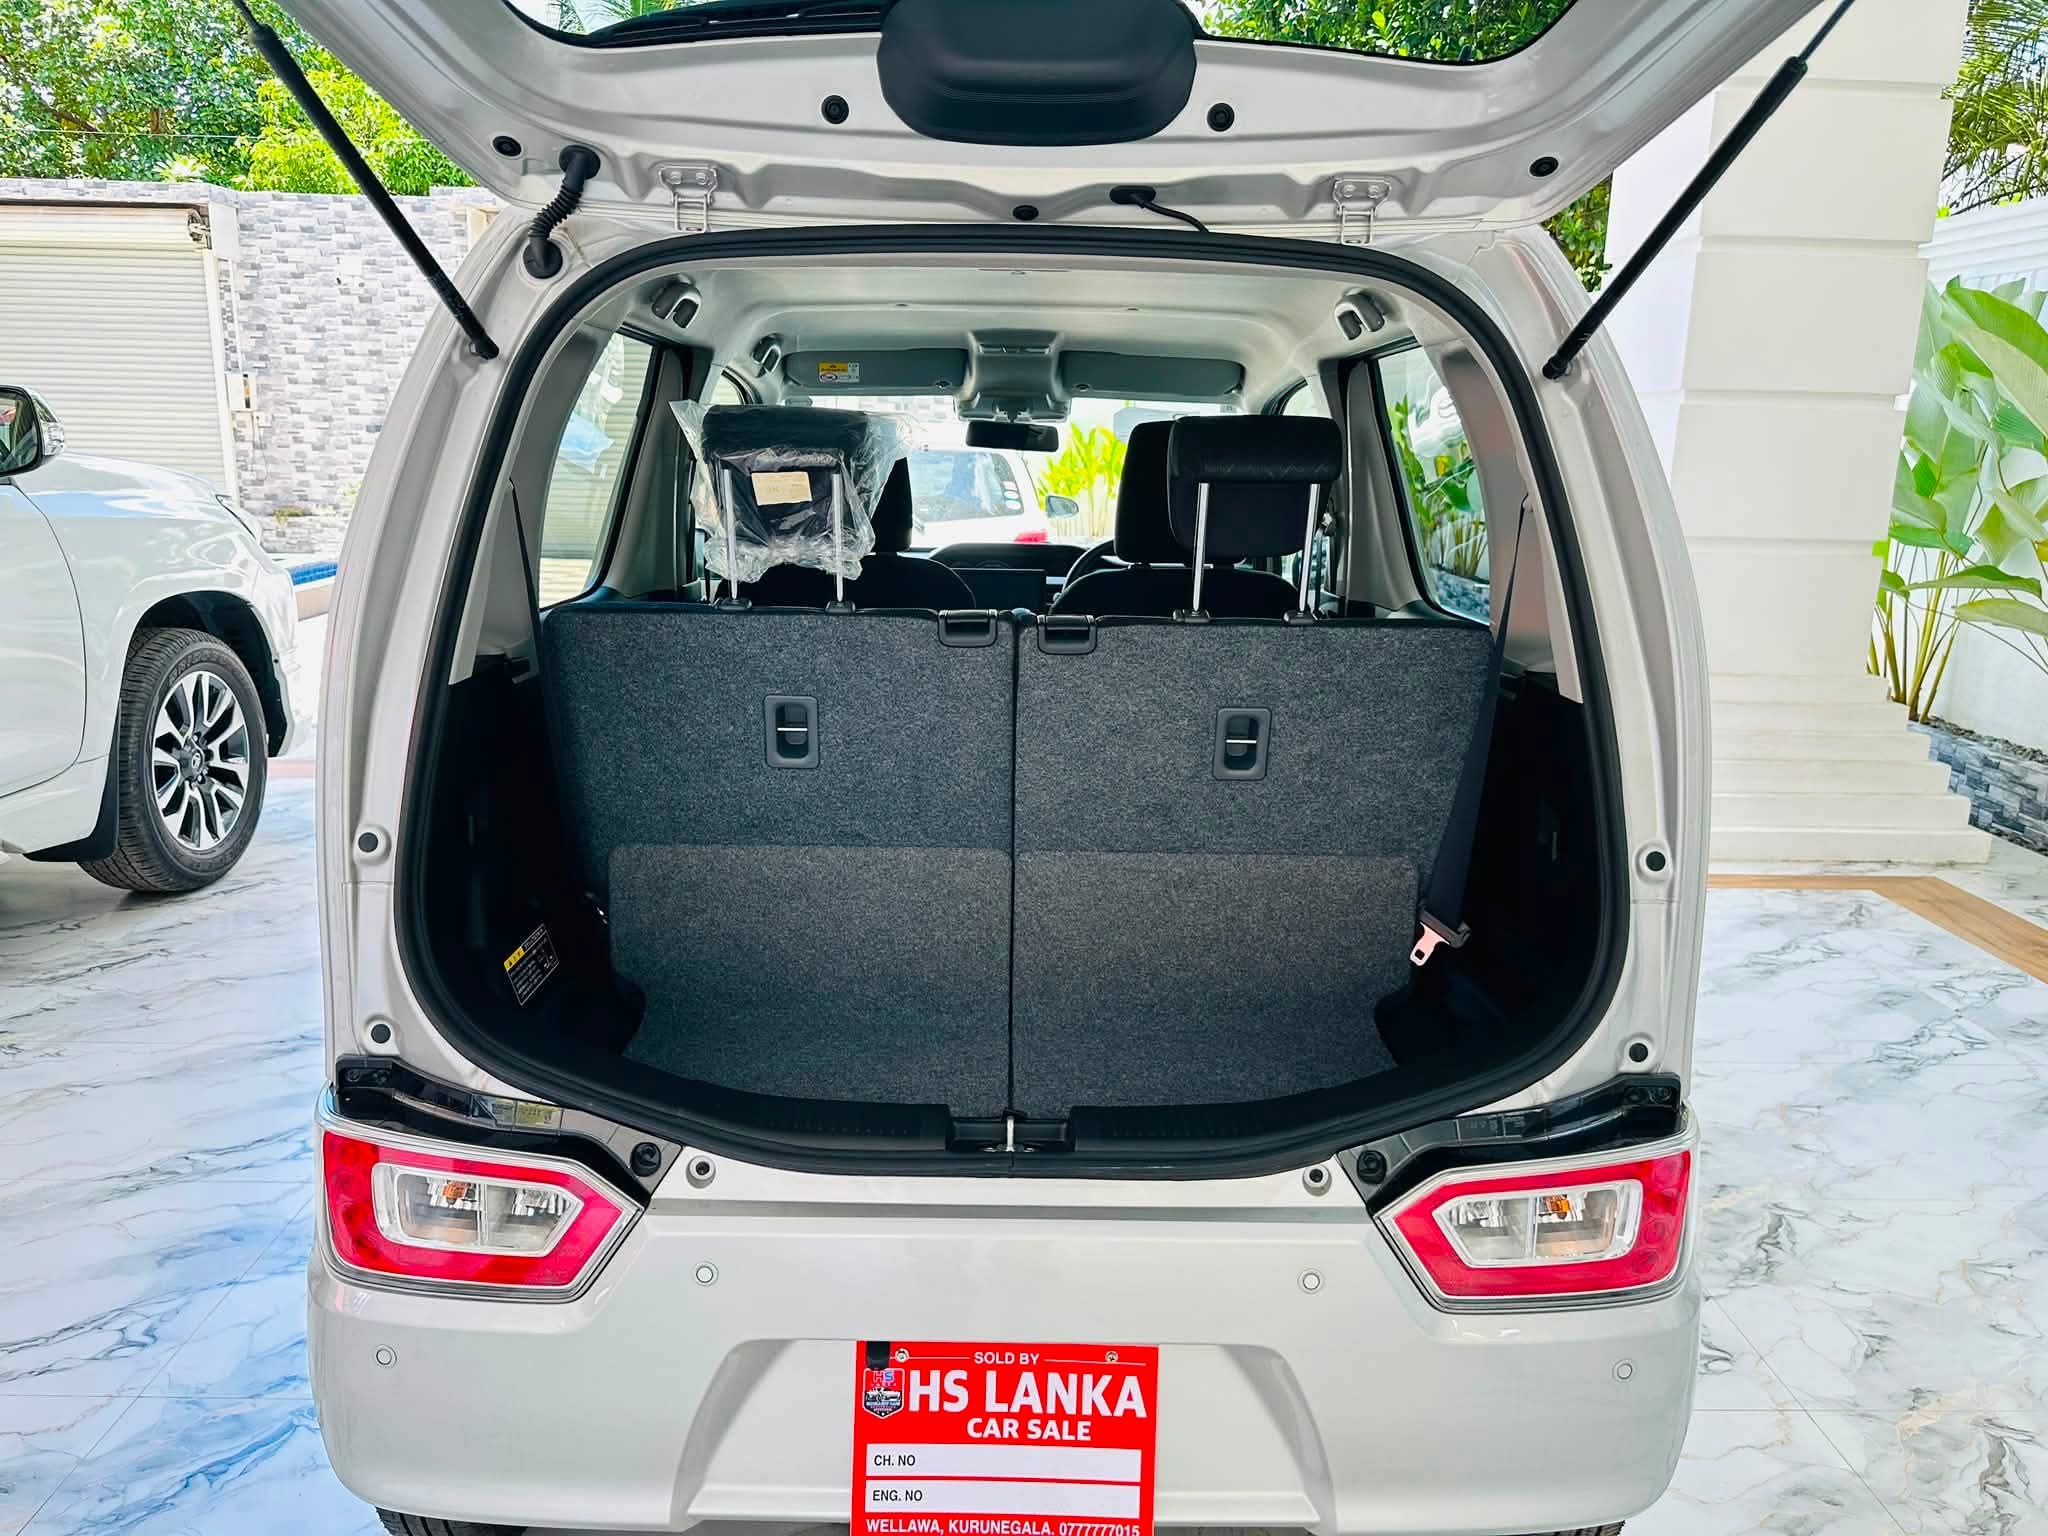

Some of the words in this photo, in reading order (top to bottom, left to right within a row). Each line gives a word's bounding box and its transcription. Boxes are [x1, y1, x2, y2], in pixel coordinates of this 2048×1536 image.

[974, 1351, 1015, 1365] SOLD
[1019, 1353, 1039, 1365] BY
[908, 1368, 969, 1413] HS
[985, 1370, 1148, 1418] LANKA
[967, 1417, 1019, 1439] CAR
[1027, 1418, 1092, 1441] SALE
[874, 1455, 894, 1466] CH.
[898, 1455, 916, 1466] NO
[873, 1490, 901, 1501] ENG.
[905, 1490, 923, 1501] NO
[866, 1519, 944, 1535] WELLAWA,
[948, 1520, 1055, 1535] KURUNEGALA.
[1059, 1522, 1140, 1536] 0777777015
